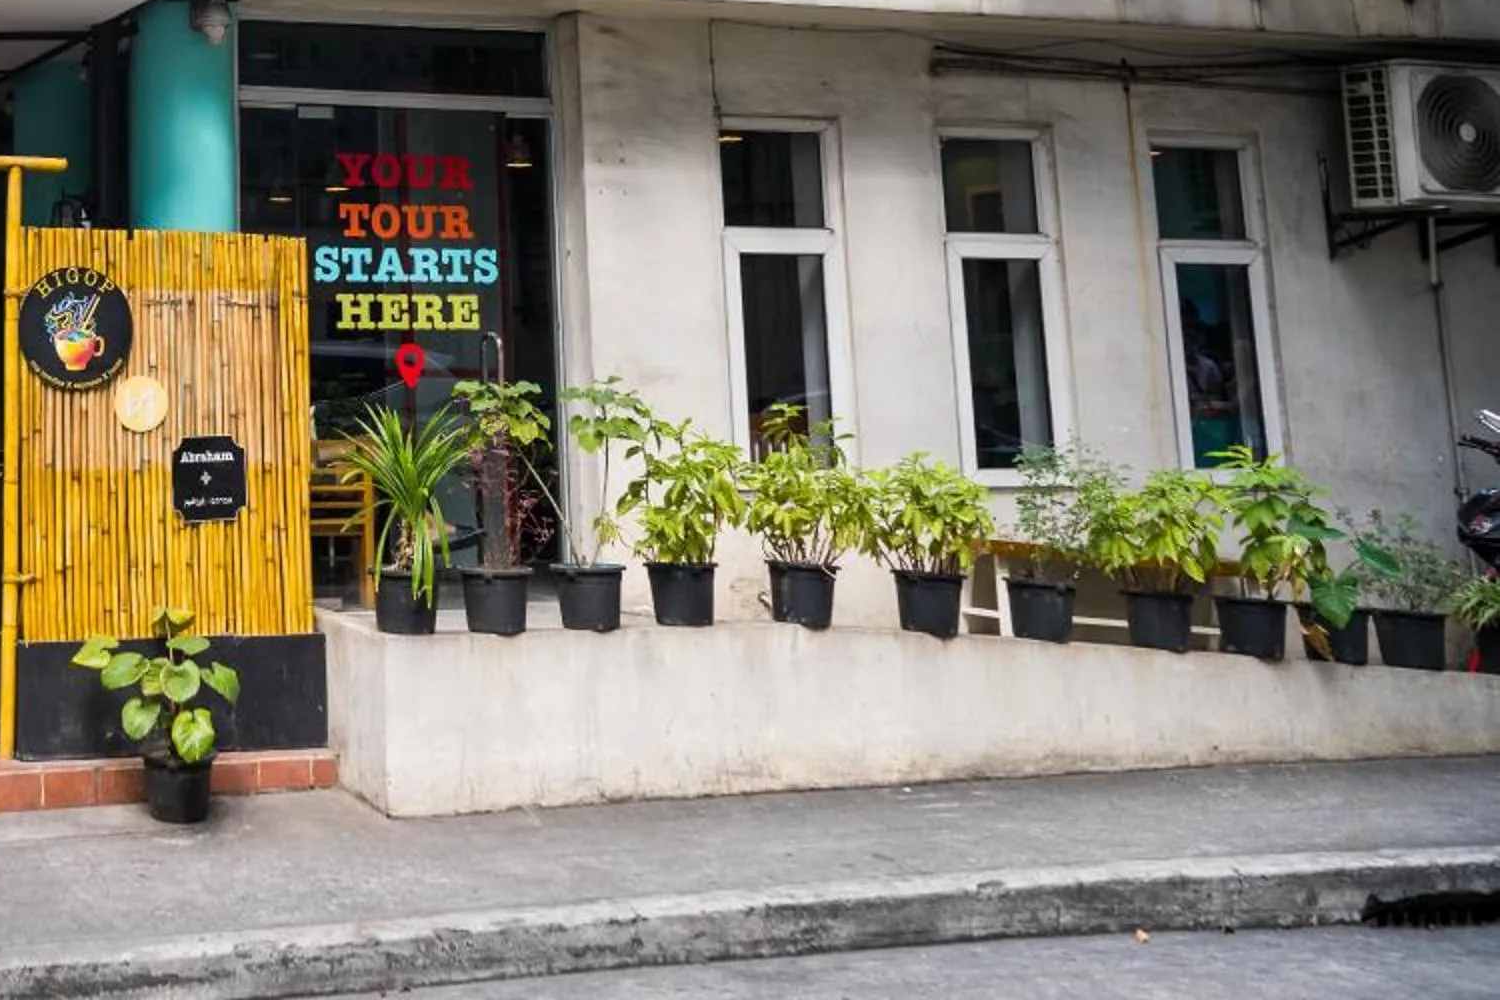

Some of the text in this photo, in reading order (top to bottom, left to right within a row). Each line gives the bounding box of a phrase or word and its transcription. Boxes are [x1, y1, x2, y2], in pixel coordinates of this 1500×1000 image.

[335, 153, 474, 190] YOUR
[339, 203, 474, 239] TOUR
[35, 267, 115, 299] HIGOP
[313, 246, 499, 284] STARTS
[335, 293, 481, 331] HERE
[180, 450, 235, 463] Abraham
